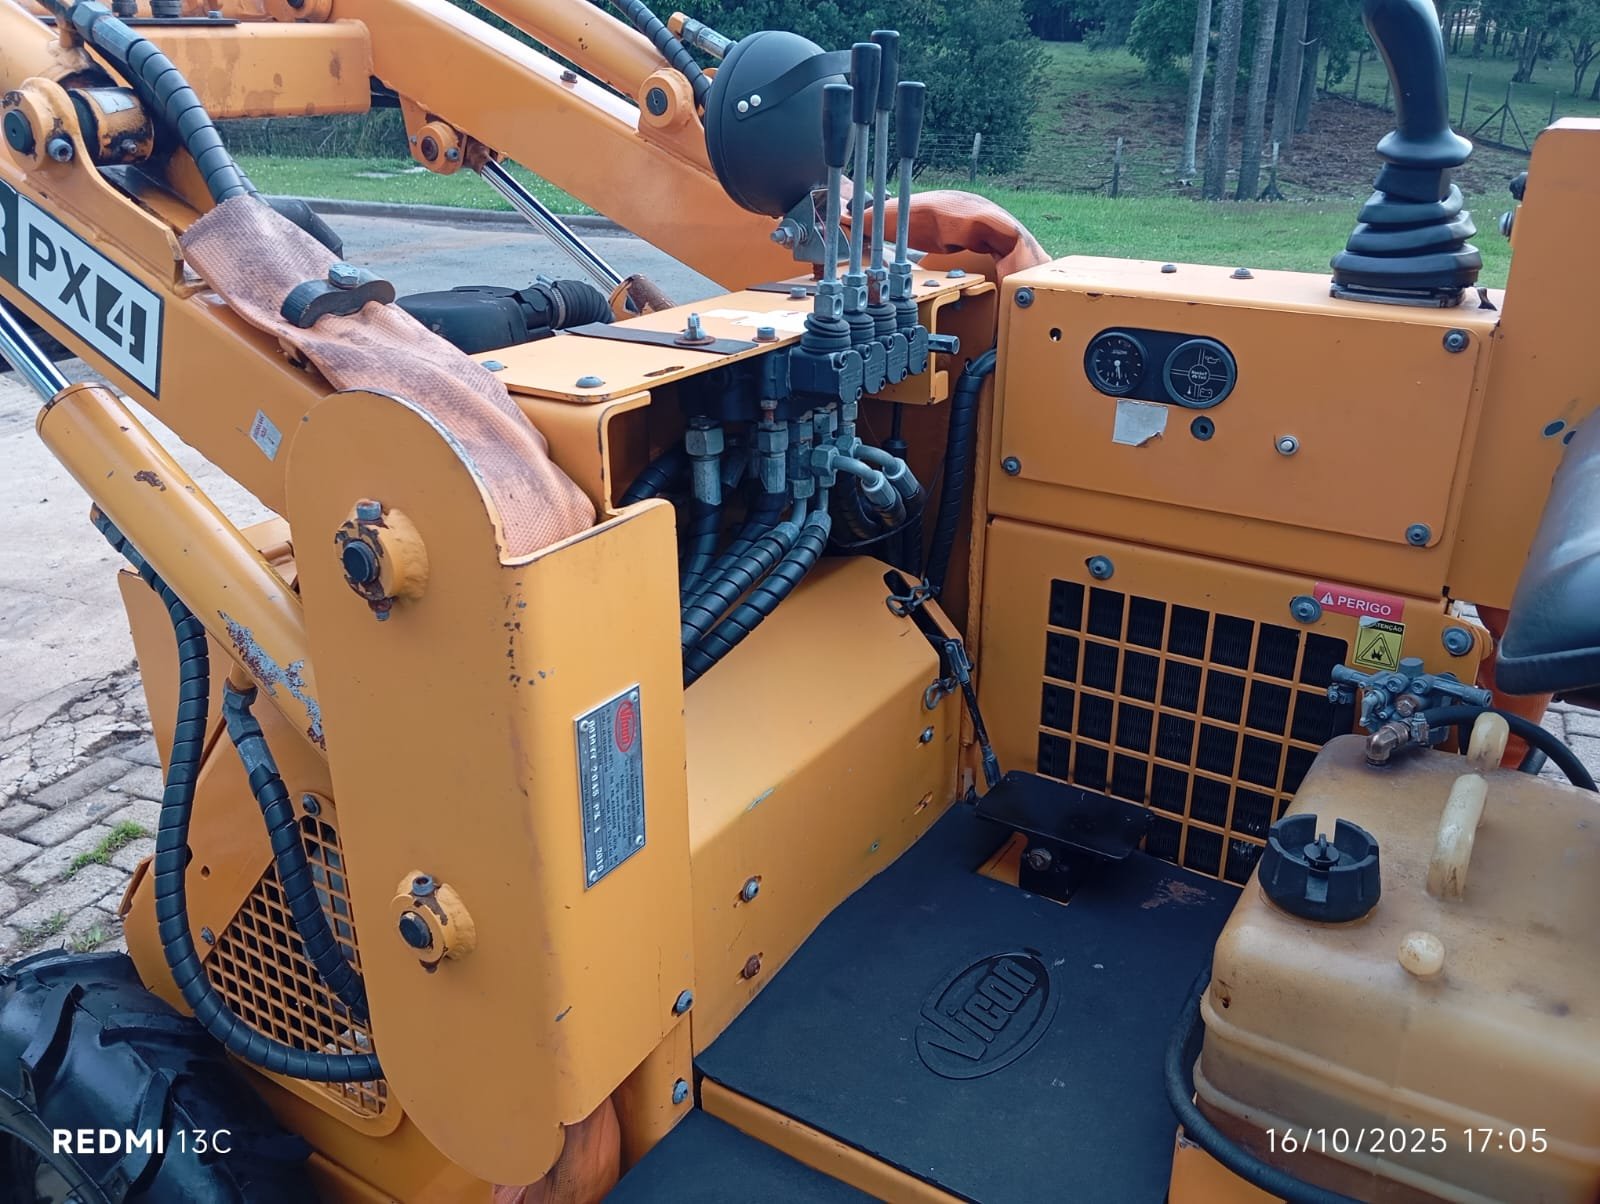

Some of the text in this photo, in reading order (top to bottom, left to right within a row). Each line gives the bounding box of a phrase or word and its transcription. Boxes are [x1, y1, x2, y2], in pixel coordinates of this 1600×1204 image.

[28, 222, 147, 365] PX4
[1337, 595, 1392, 616] PERIGO
[1376, 622, 1404, 633] TENÇÃO
[916, 957, 1038, 1062] Vicon
